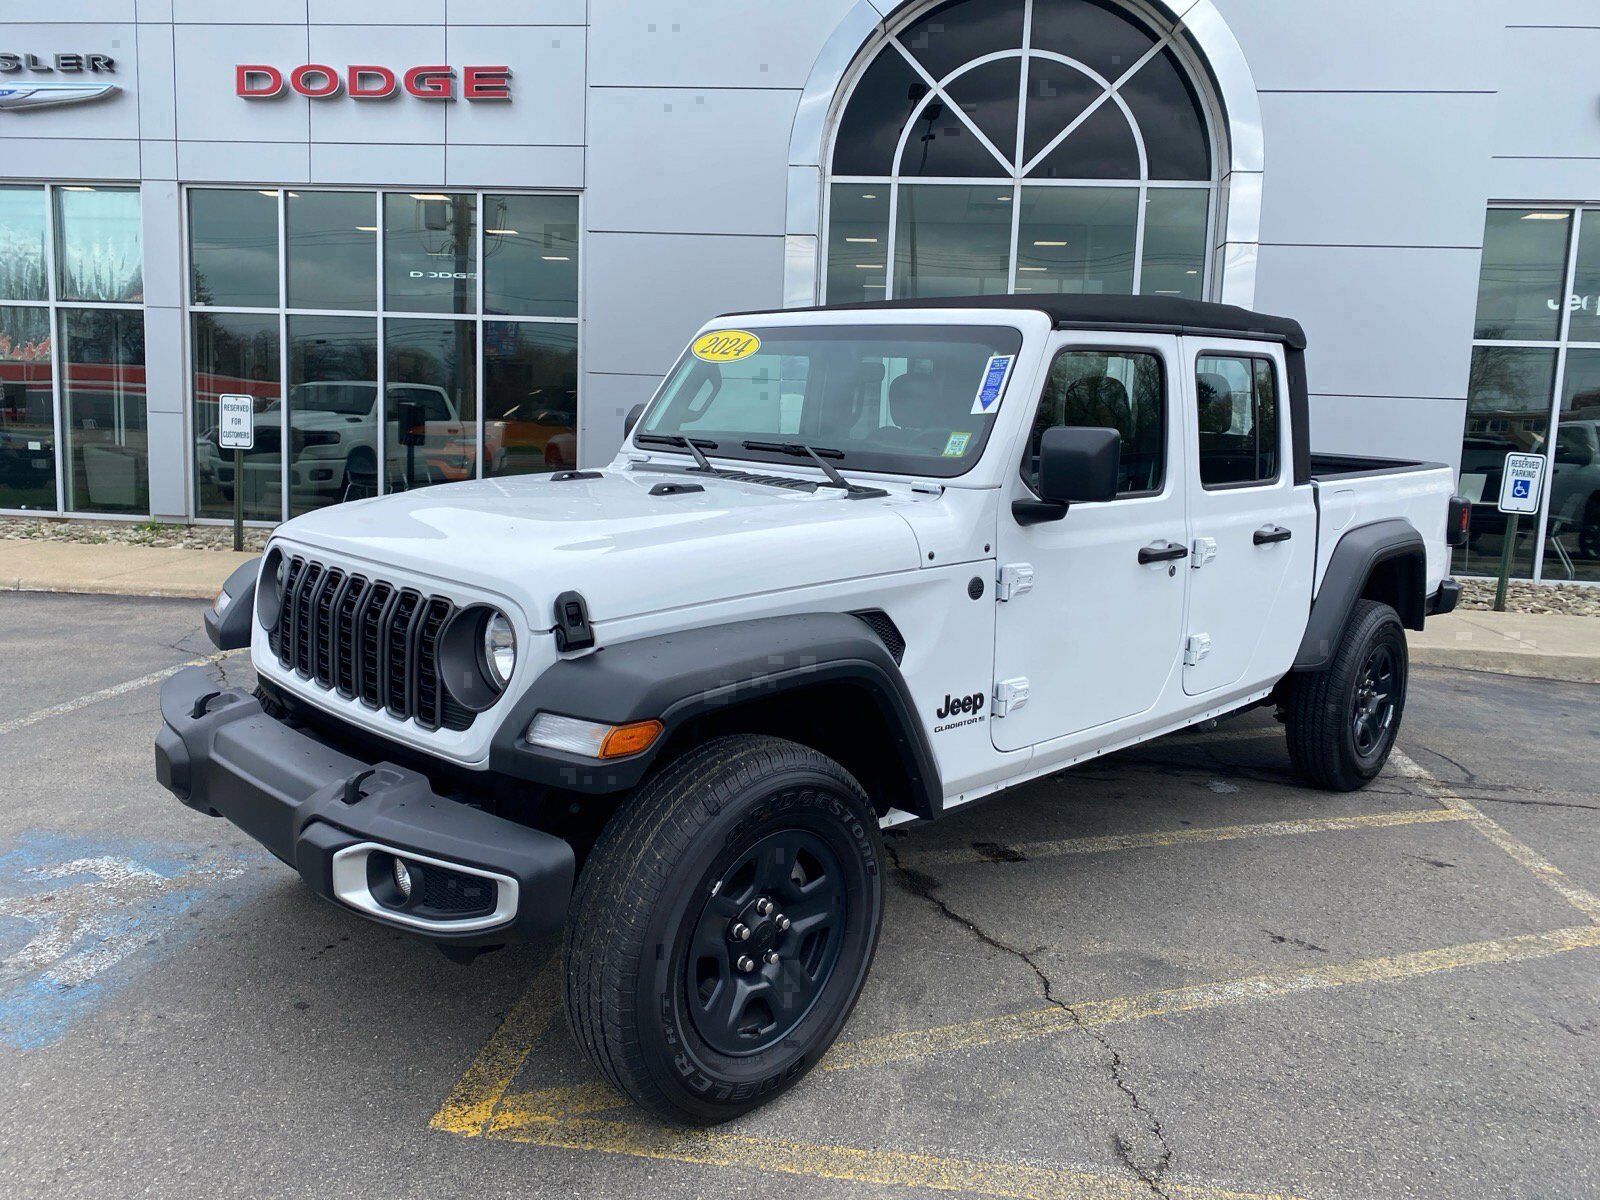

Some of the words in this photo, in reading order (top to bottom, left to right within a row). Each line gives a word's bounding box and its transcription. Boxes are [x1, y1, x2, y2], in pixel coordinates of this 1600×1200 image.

[235, 64, 512, 102] DODGE
[699, 336, 753, 356] 2024
[223, 404, 249, 412] RESERVED
[223, 431, 249, 439] CUSTOMERS
[1510, 459, 1540, 470] RESERVED
[1511, 468, 1537, 479] PARKING
[936, 692, 985, 719] Jeep
[934, 717, 978, 733] GLADIATOR
